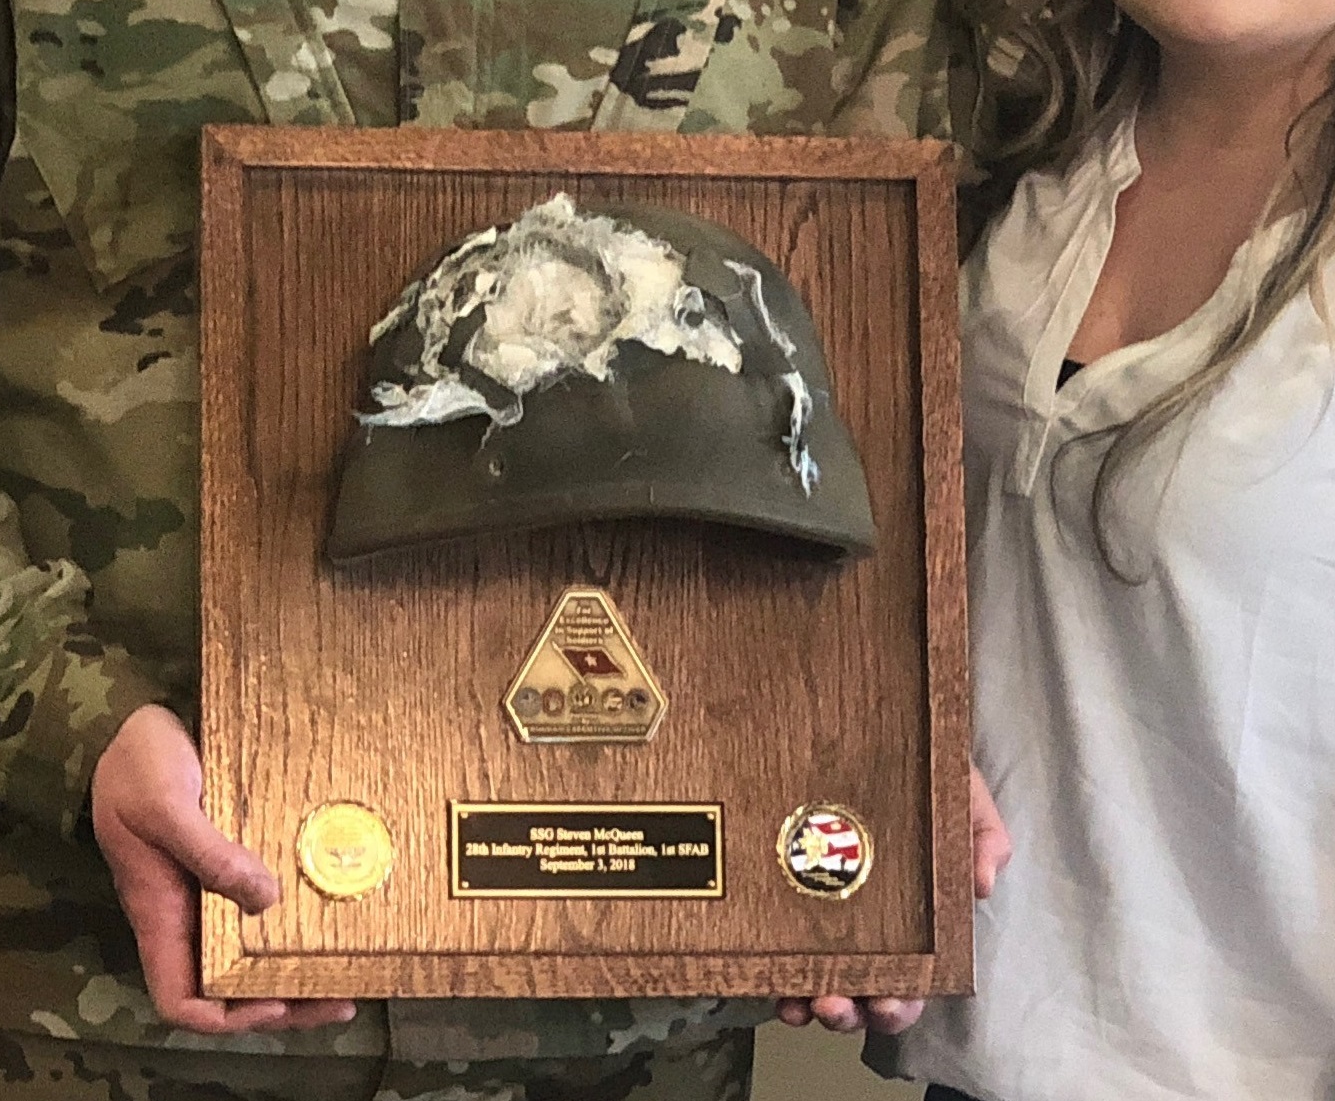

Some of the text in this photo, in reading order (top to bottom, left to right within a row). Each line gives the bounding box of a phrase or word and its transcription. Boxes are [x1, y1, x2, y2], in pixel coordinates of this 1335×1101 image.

[557, 828, 592, 841] Steven
[594, 828, 644, 842] McQueen
[465, 843, 710, 858] 28th Infantry Regiment, 1st Battalion, 1st SFAB
[540, 858, 636, 874] September 3, 2018
